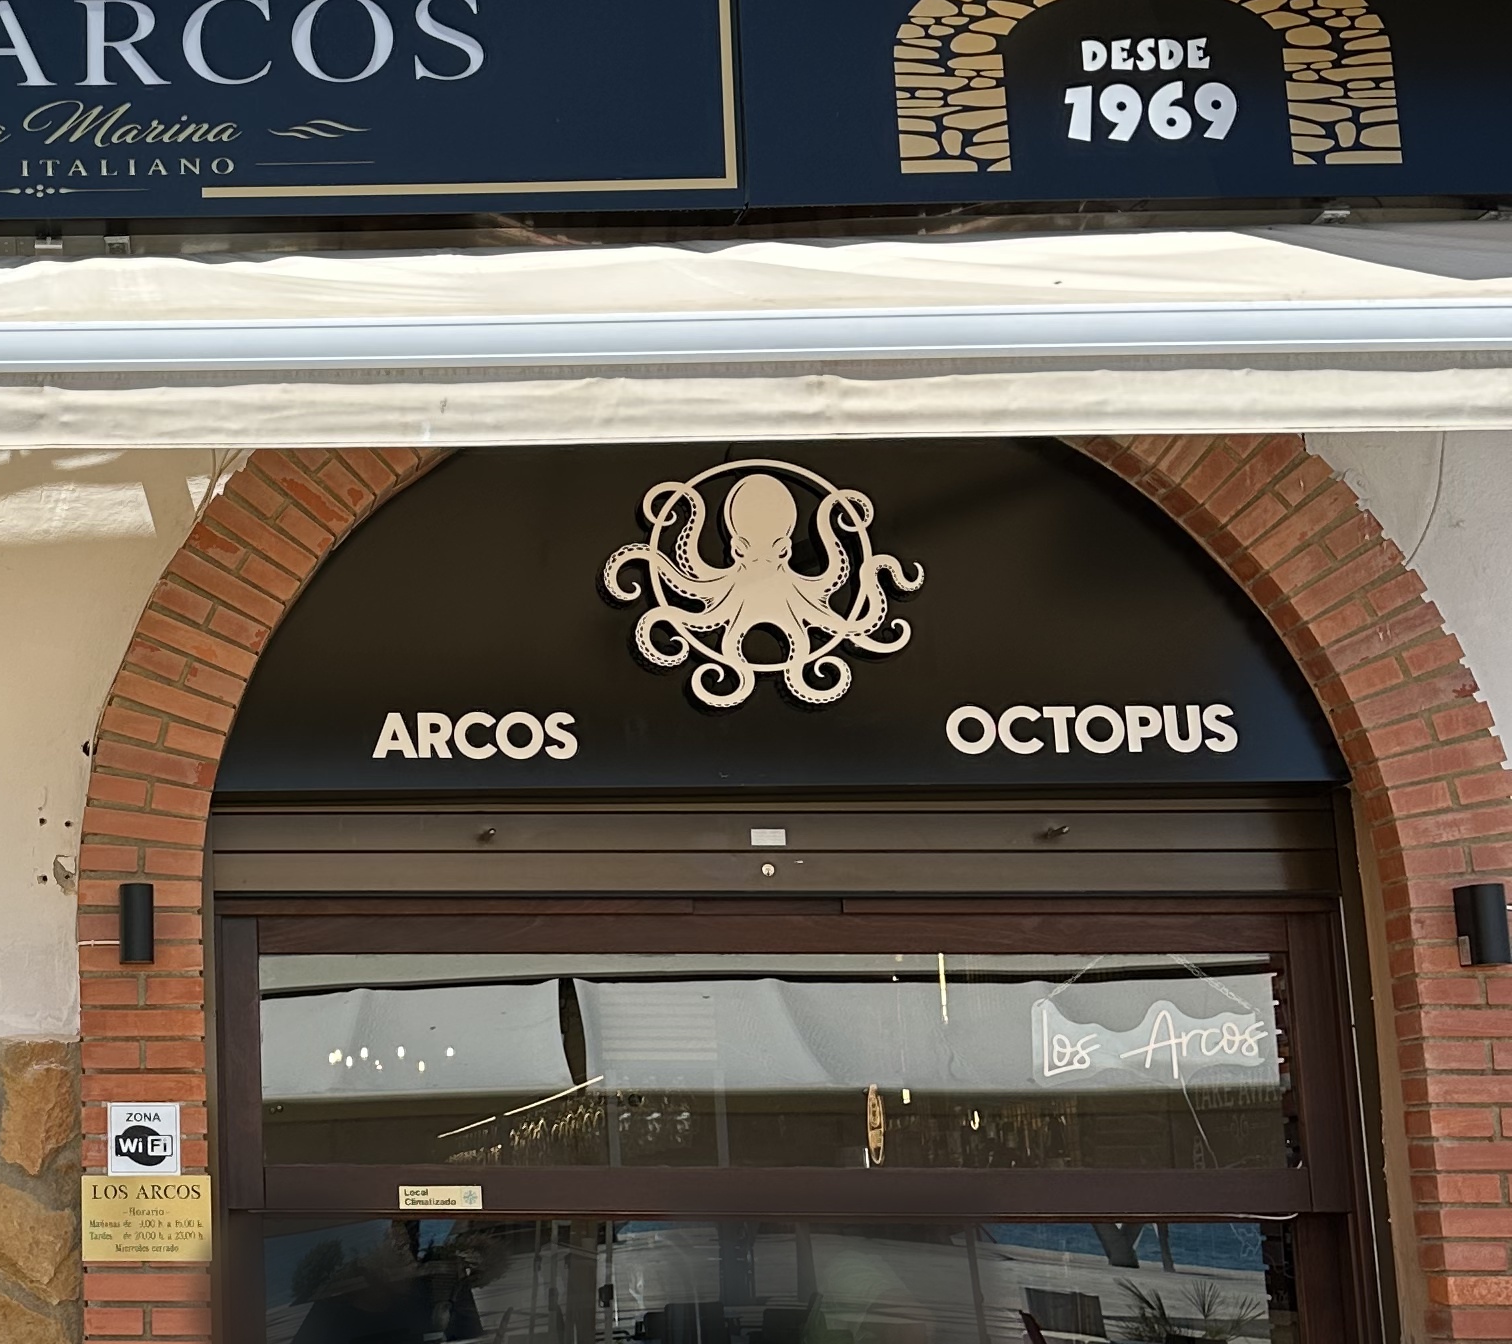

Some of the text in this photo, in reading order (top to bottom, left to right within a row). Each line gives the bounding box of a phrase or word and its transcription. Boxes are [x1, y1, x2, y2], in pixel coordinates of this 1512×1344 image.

[1081, 37, 1211, 72] DESDE
[22, 100, 243, 148] Marina
[1064, 80, 1237, 142] 1969
[21, 157, 235, 177] ITALIANO
[372, 711, 578, 760] ARCOS
[945, 703, 1238, 755] OCTOPUS
[1042, 1009, 1268, 1080] Los Arcos
[125, 1112, 162, 1123] ZONA
[91, 1184, 202, 1200] LOS ARCOS
[404, 1188, 429, 1196] Local
[405, 1197, 457, 1206] Climatizado
